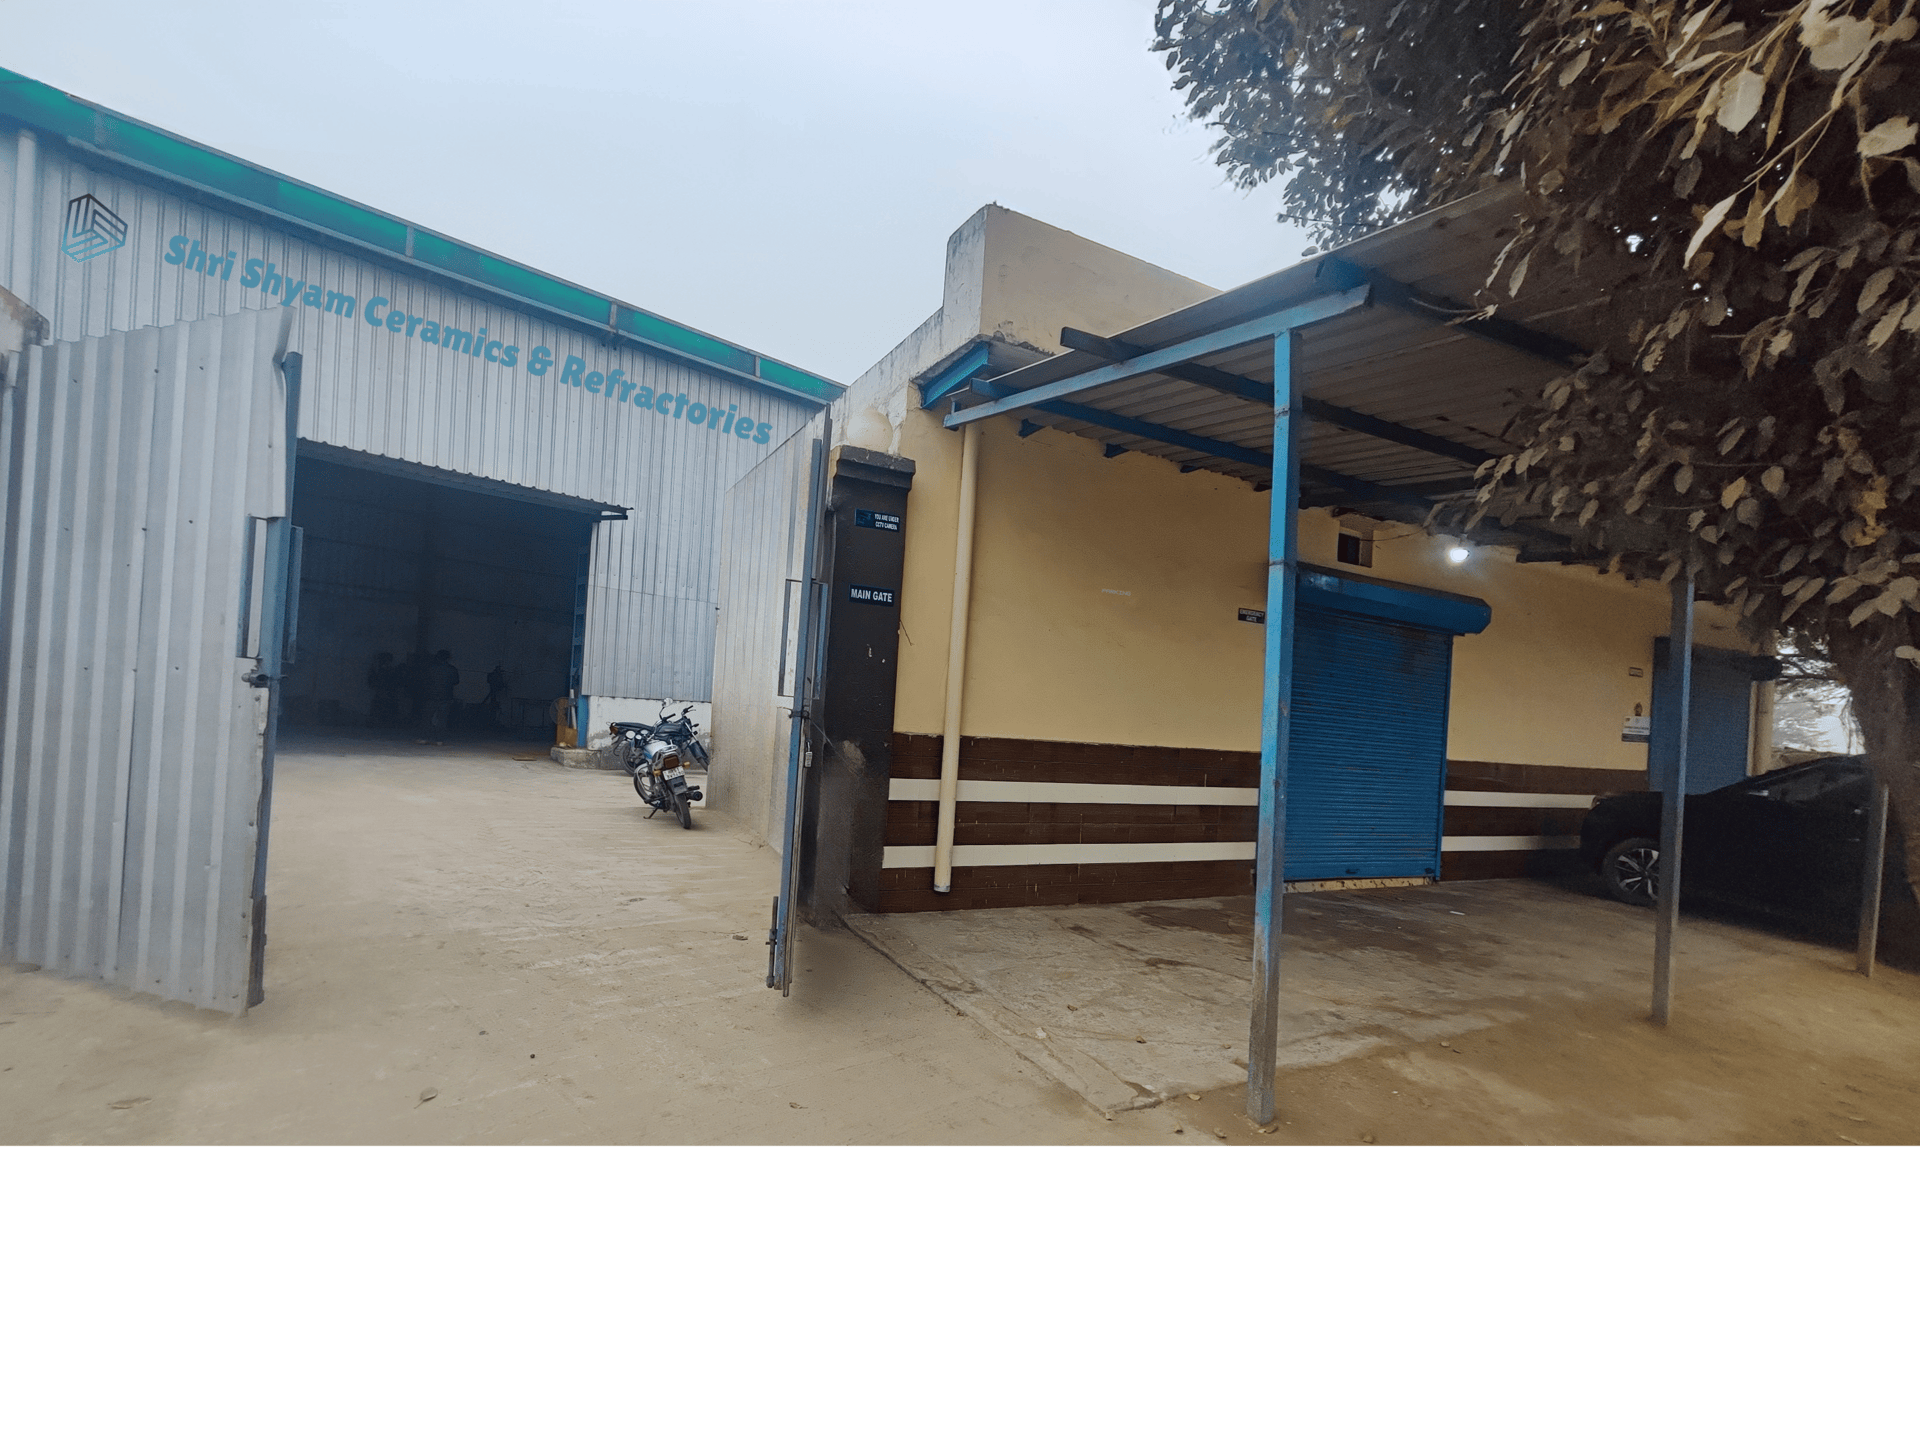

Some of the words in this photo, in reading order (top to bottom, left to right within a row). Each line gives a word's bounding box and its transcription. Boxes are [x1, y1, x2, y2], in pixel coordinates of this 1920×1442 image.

[164, 235, 237, 281] Shri
[240, 258, 356, 318] Shyam
[364, 296, 520, 367] Ceramics
[526, 345, 553, 381] &
[559, 354, 773, 445] Refractories
[851, 588, 871, 600] MAIN
[872, 591, 892, 602] GATE
